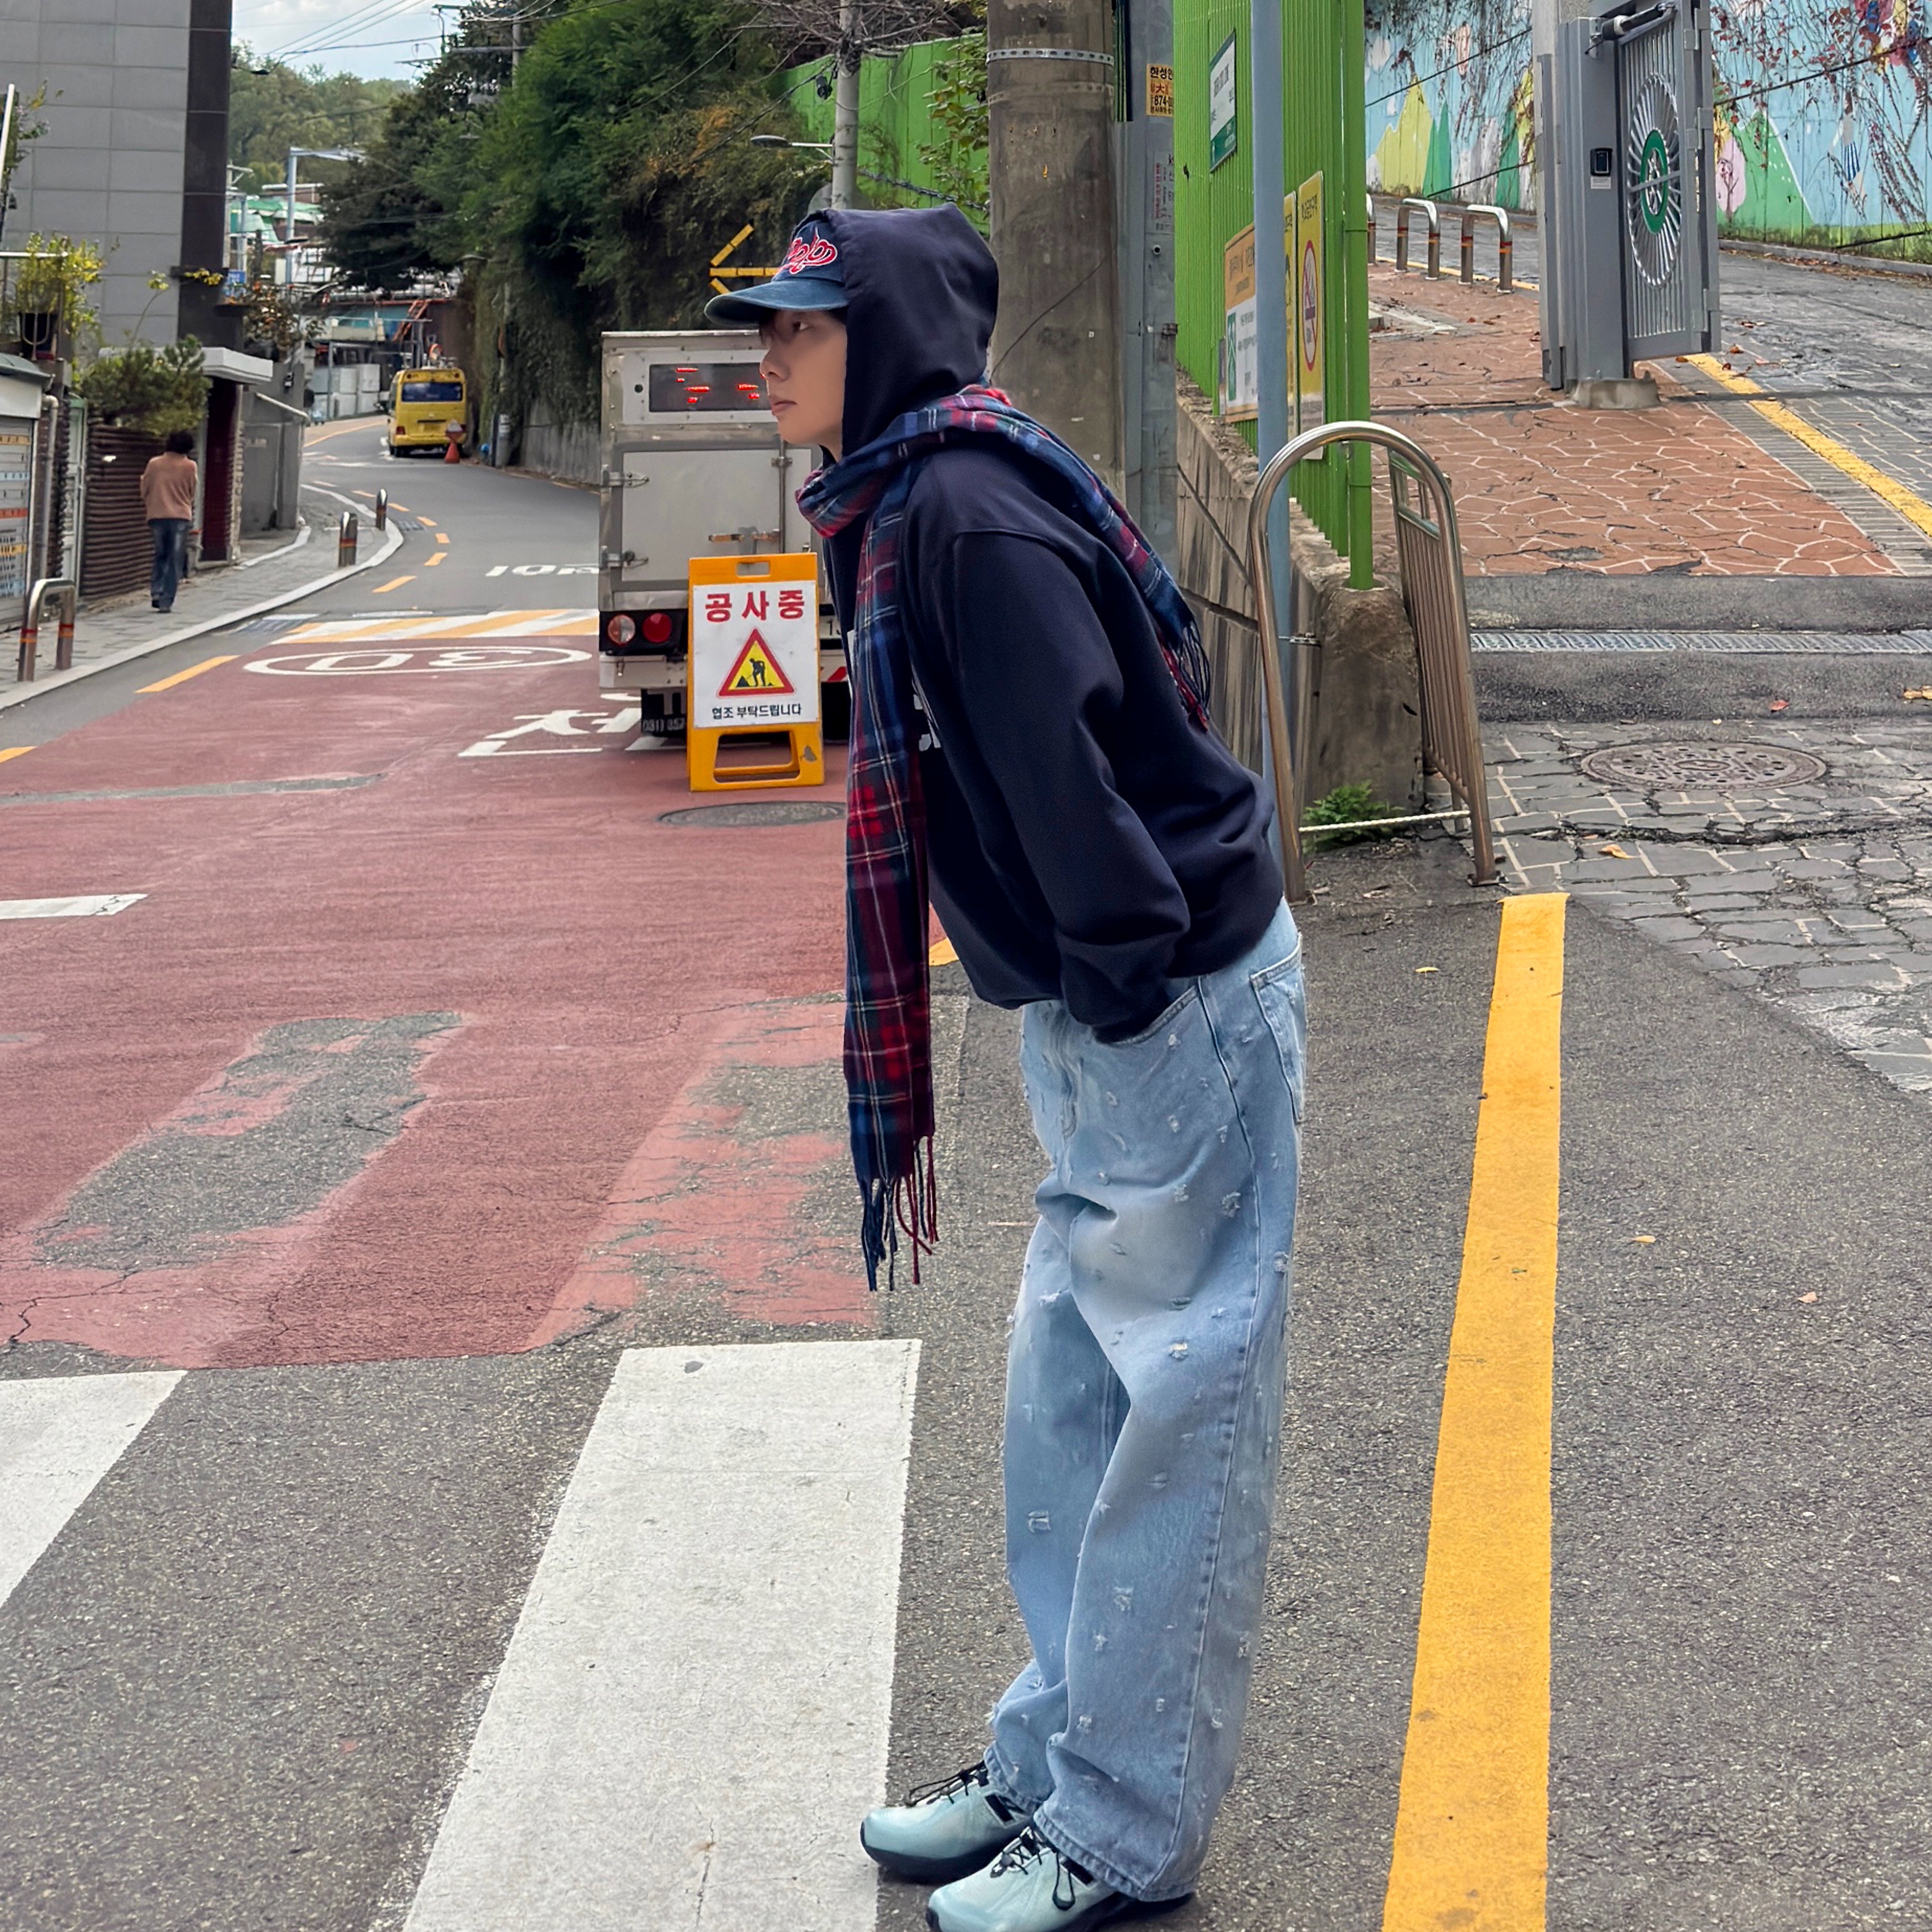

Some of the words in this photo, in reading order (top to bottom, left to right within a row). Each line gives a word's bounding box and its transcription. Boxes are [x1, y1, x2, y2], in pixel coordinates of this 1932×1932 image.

[705, 590, 805, 623] 공사중
[712, 706, 734, 720] 협조
[737, 702, 802, 718] 부탁드립니다
